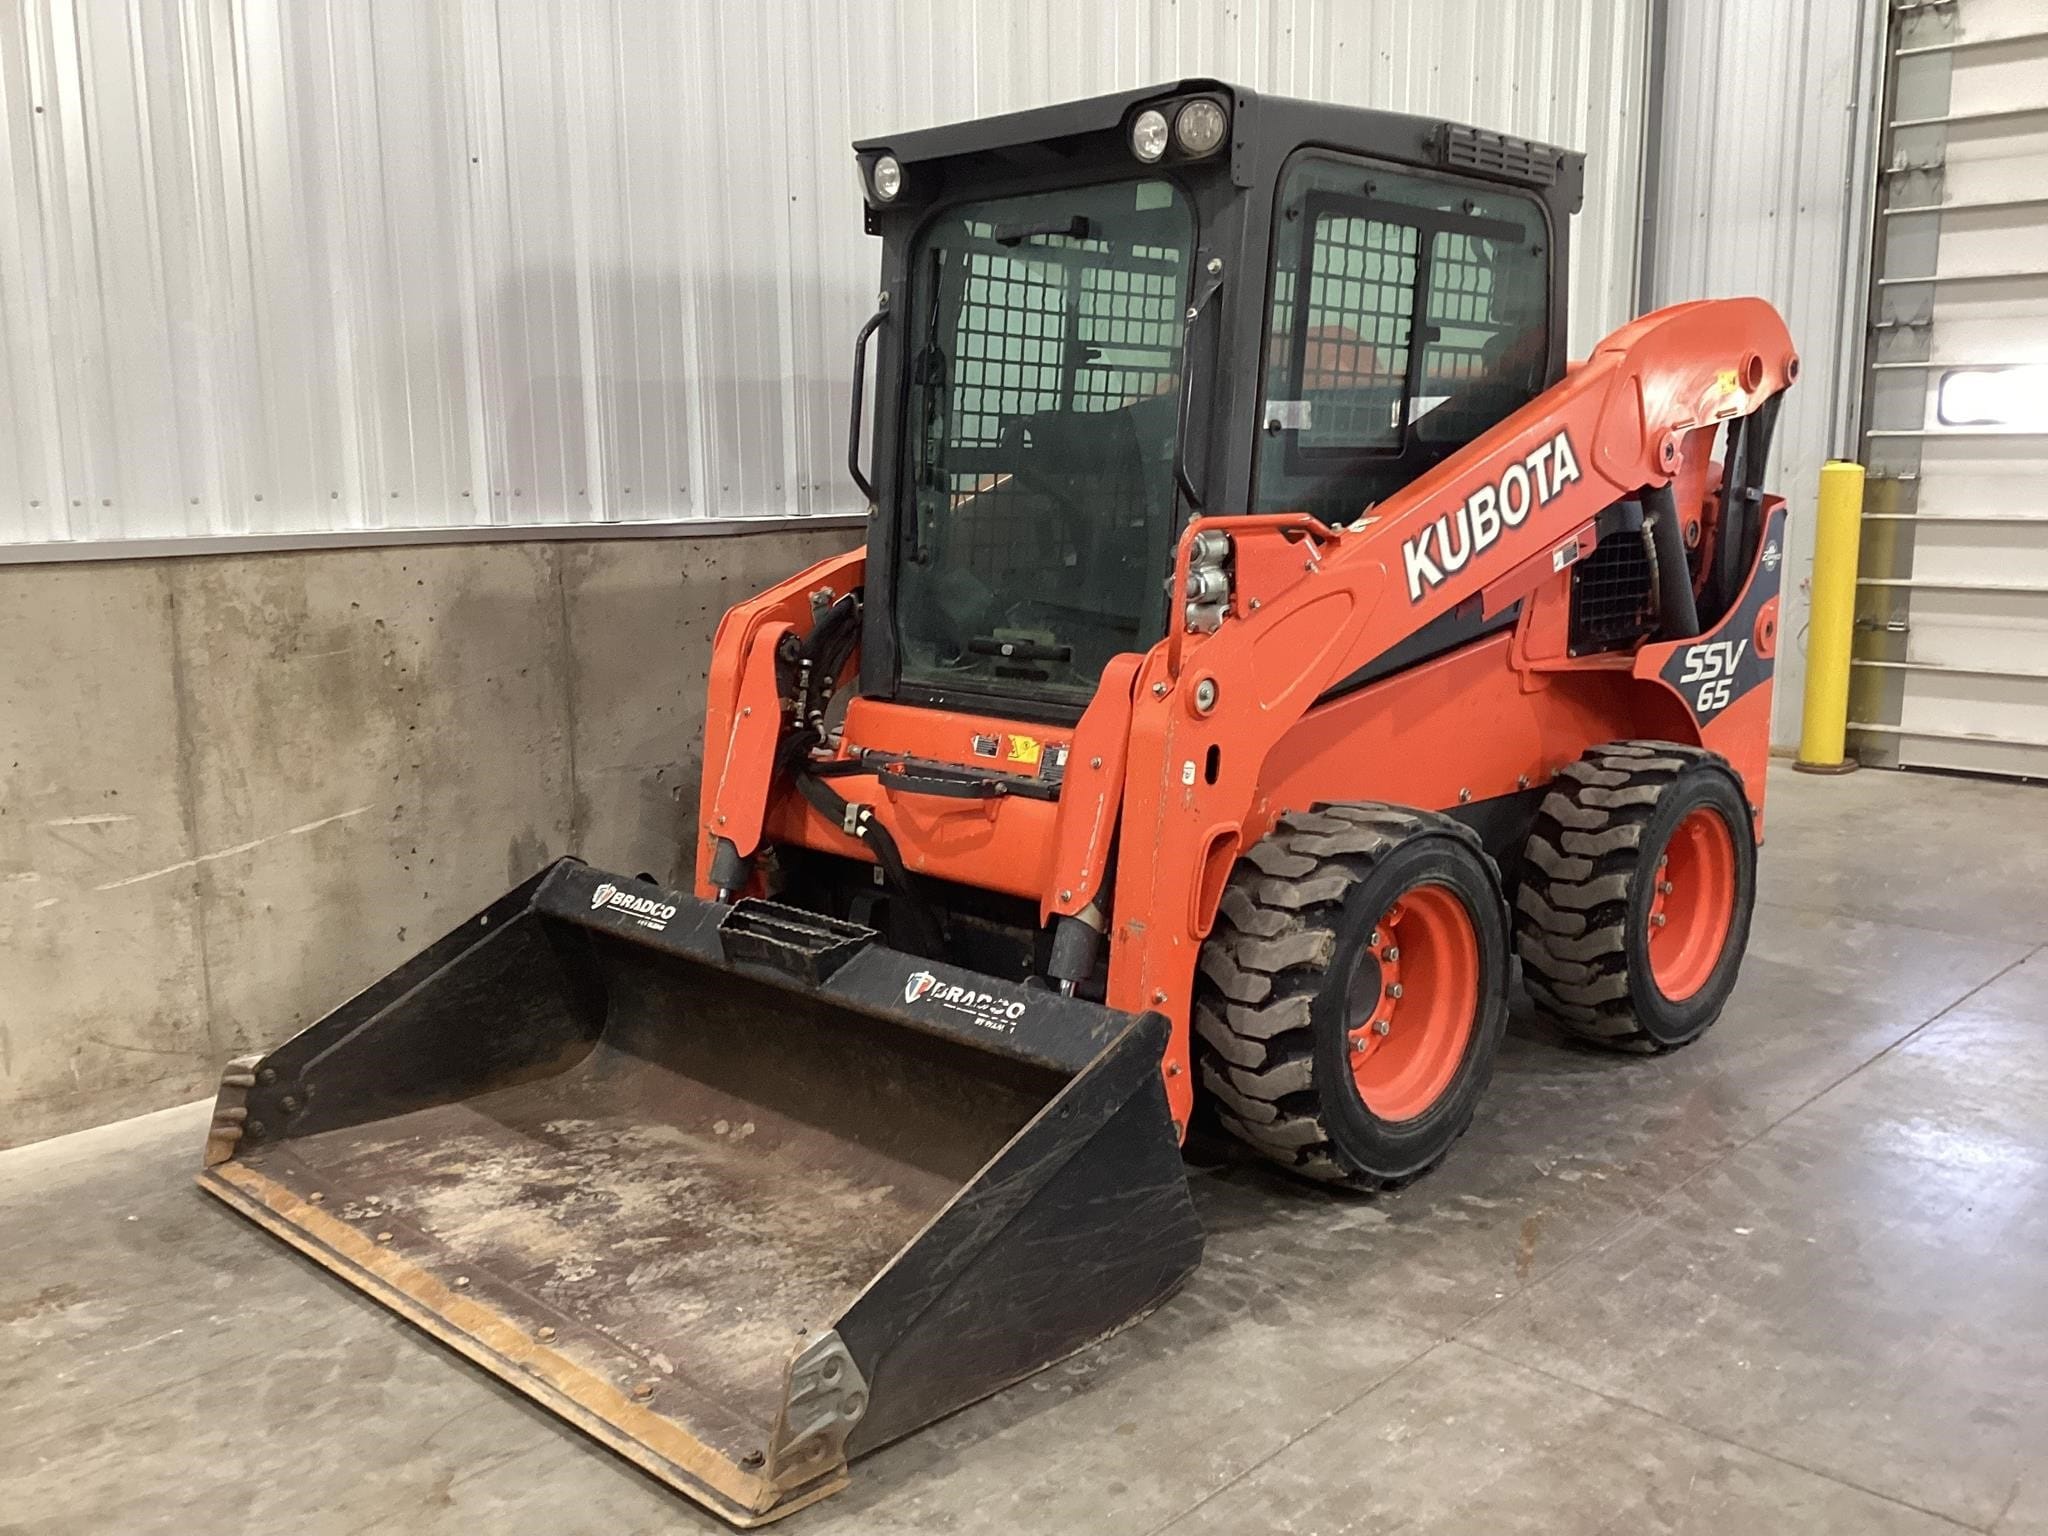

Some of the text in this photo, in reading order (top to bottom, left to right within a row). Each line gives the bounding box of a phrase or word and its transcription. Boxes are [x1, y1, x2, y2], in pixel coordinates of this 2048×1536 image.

[1402, 430, 1580, 602] KUBOTA
[1680, 638, 1748, 684] SSV
[1696, 678, 1733, 712] 65
[609, 892, 677, 920] BRADCO
